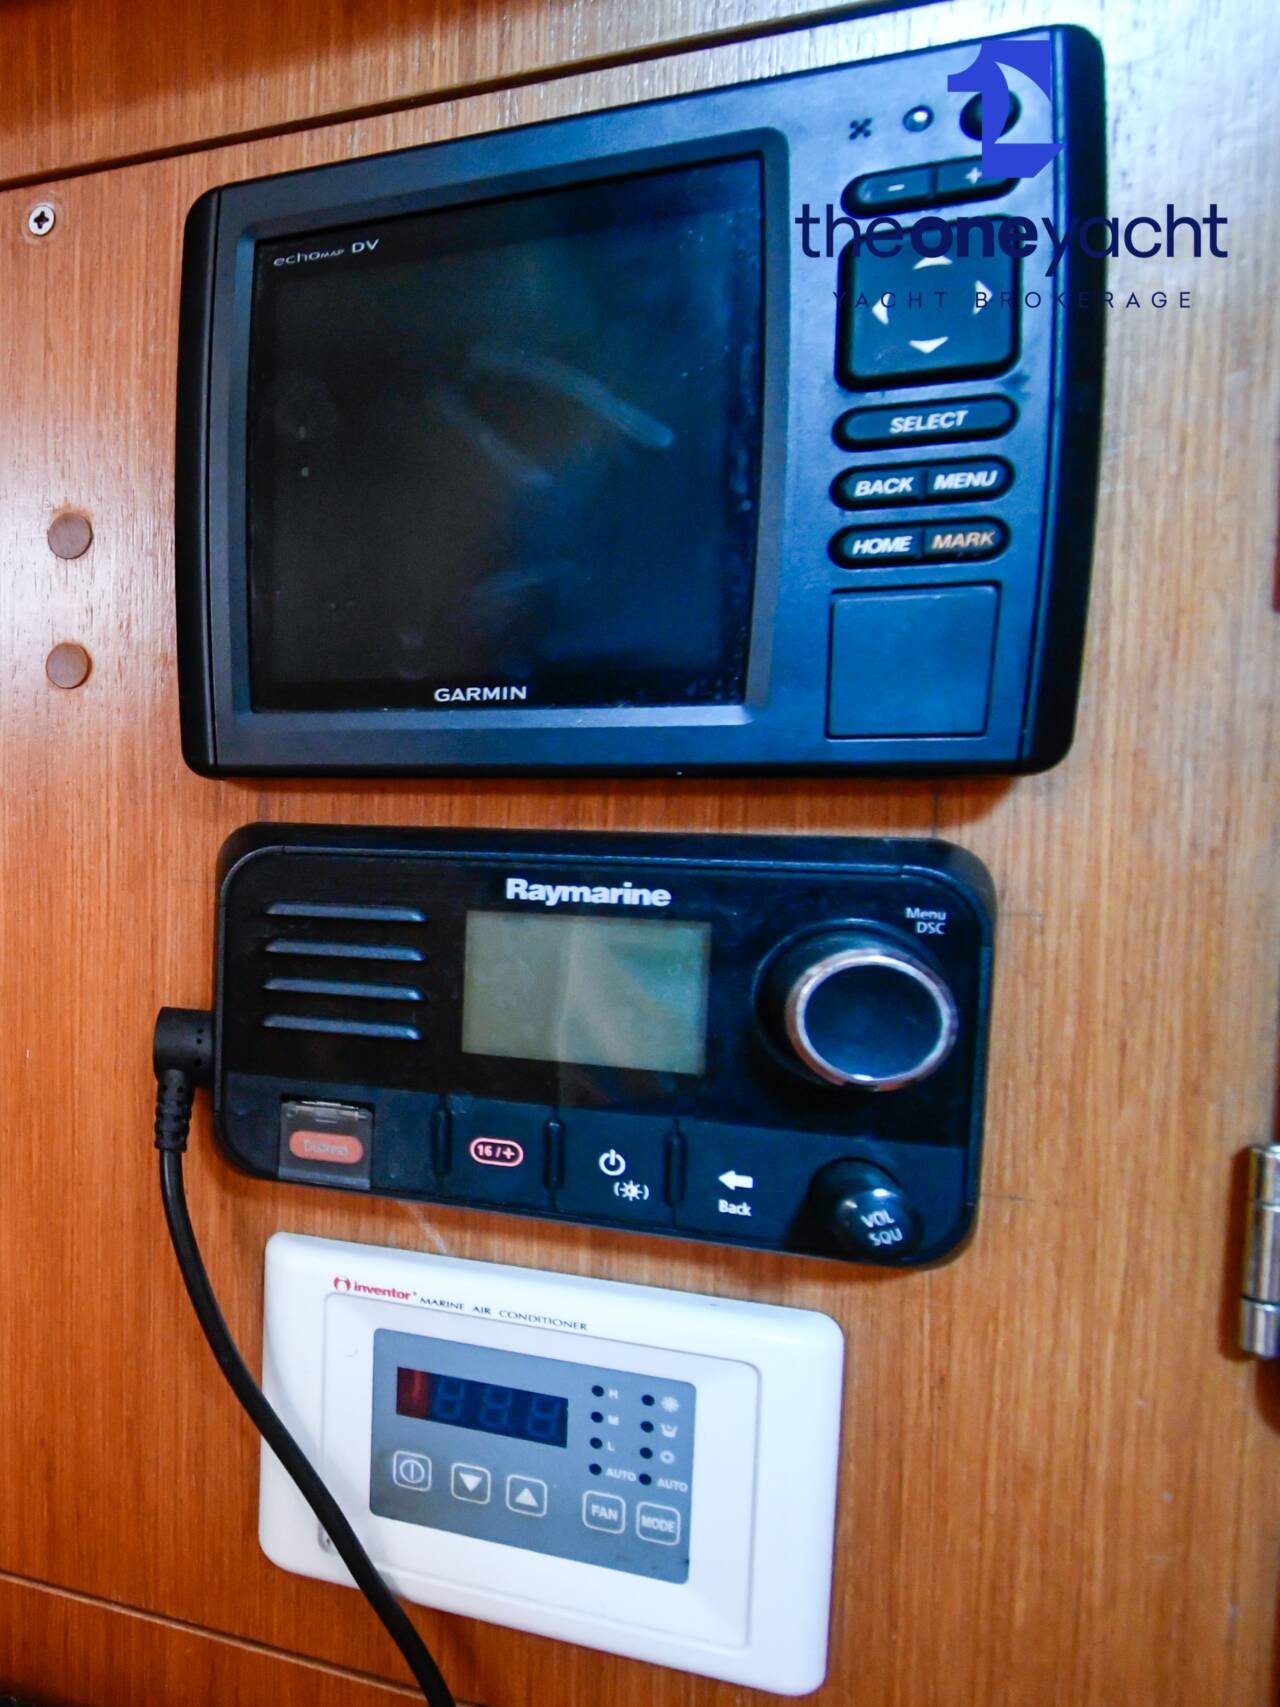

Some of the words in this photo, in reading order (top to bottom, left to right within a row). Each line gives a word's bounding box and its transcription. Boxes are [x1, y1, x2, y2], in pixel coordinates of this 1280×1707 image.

[351, 238, 380, 254] DV
[889, 410, 969, 434] SELECT
[854, 477, 914, 497] BACK
[933, 470, 998, 491] MENU
[852, 536, 913, 555] HOME
[931, 530, 996, 550] MARK
[433, 686, 527, 702] GARMIN
[506, 878, 672, 907] Raymarine
[905, 906, 947, 921] Menu
[916, 921, 946, 935] DSC
[718, 1199, 752, 1217] Back
[861, 1209, 896, 1228] VOL
[869, 1227, 904, 1247] SQU
[354, 1281, 412, 1300] inventor
[419, 1297, 465, 1312] MARINE
[472, 1304, 492, 1315] AIR
[498, 1309, 588, 1332] CONDITIONER
[606, 1467, 637, 1483] AUTO
[656, 1477, 689, 1493] AUTO
[590, 1503, 618, 1521] FAN
[640, 1514, 676, 1534] MODE
